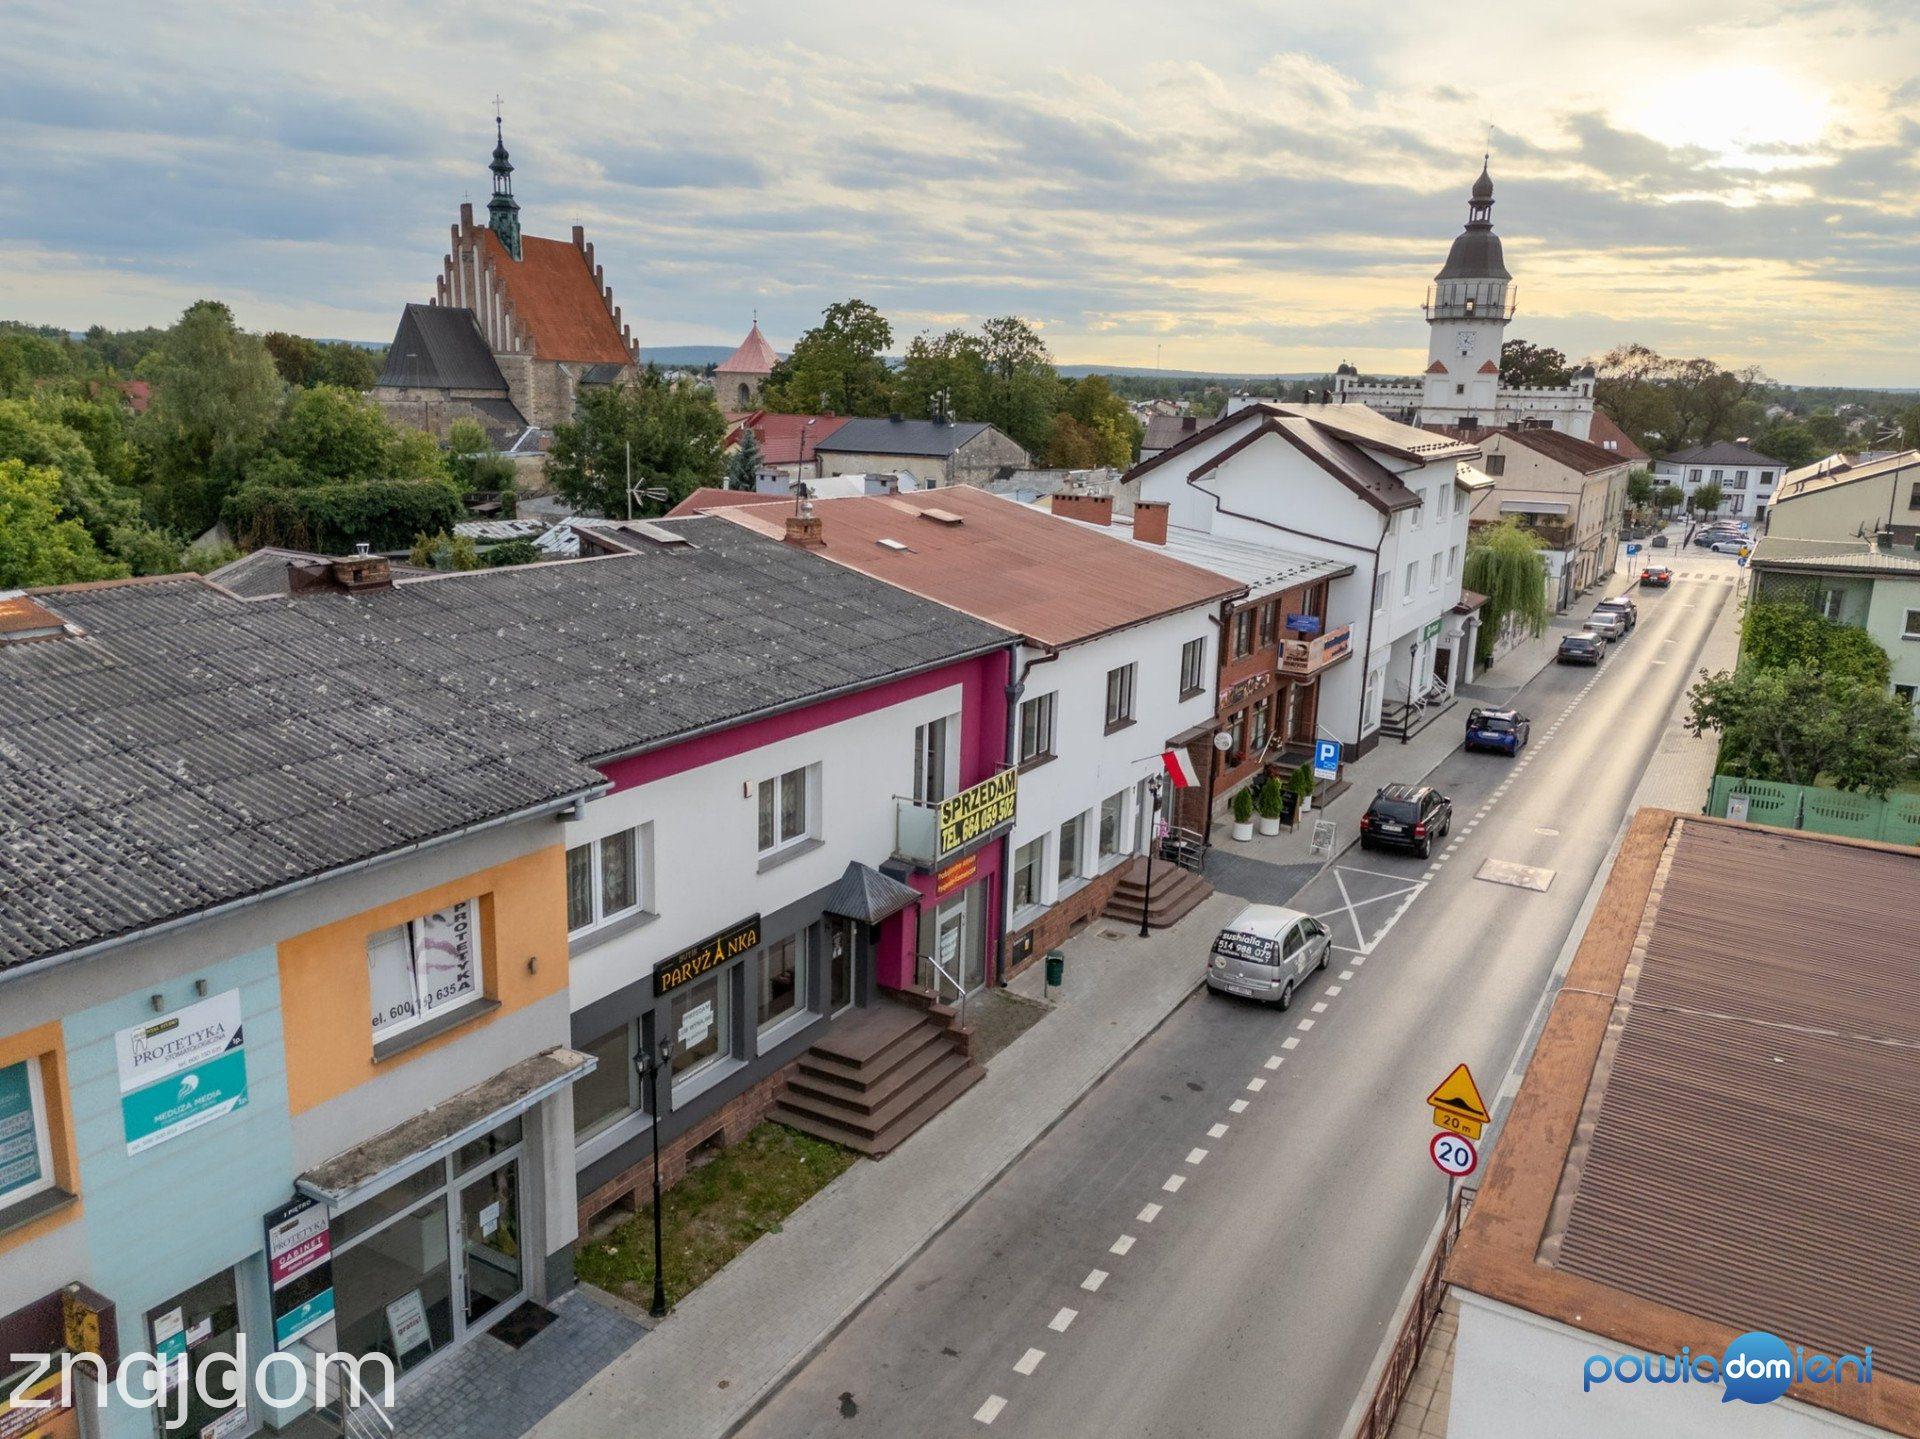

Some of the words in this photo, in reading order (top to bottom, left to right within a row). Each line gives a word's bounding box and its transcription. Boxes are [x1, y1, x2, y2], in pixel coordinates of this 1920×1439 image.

[1321, 744, 1335, 761] P
[943, 770, 1016, 825] SPRZEDAM
[942, 825, 961, 852] TEL.
[962, 812, 980, 841] 664
[454, 902, 471, 991] PROTETYKA
[372, 1012, 387, 1026] el.
[389, 1001, 411, 1018] 600
[436, 983, 456, 1000] 635
[133, 1022, 225, 1067] PROTETYKA
[1443, 1115, 1459, 1128] 20
[1462, 1125, 1471, 1133] m
[1438, 1142, 1469, 1167] 20
[279, 1236, 322, 1264] GABINET
